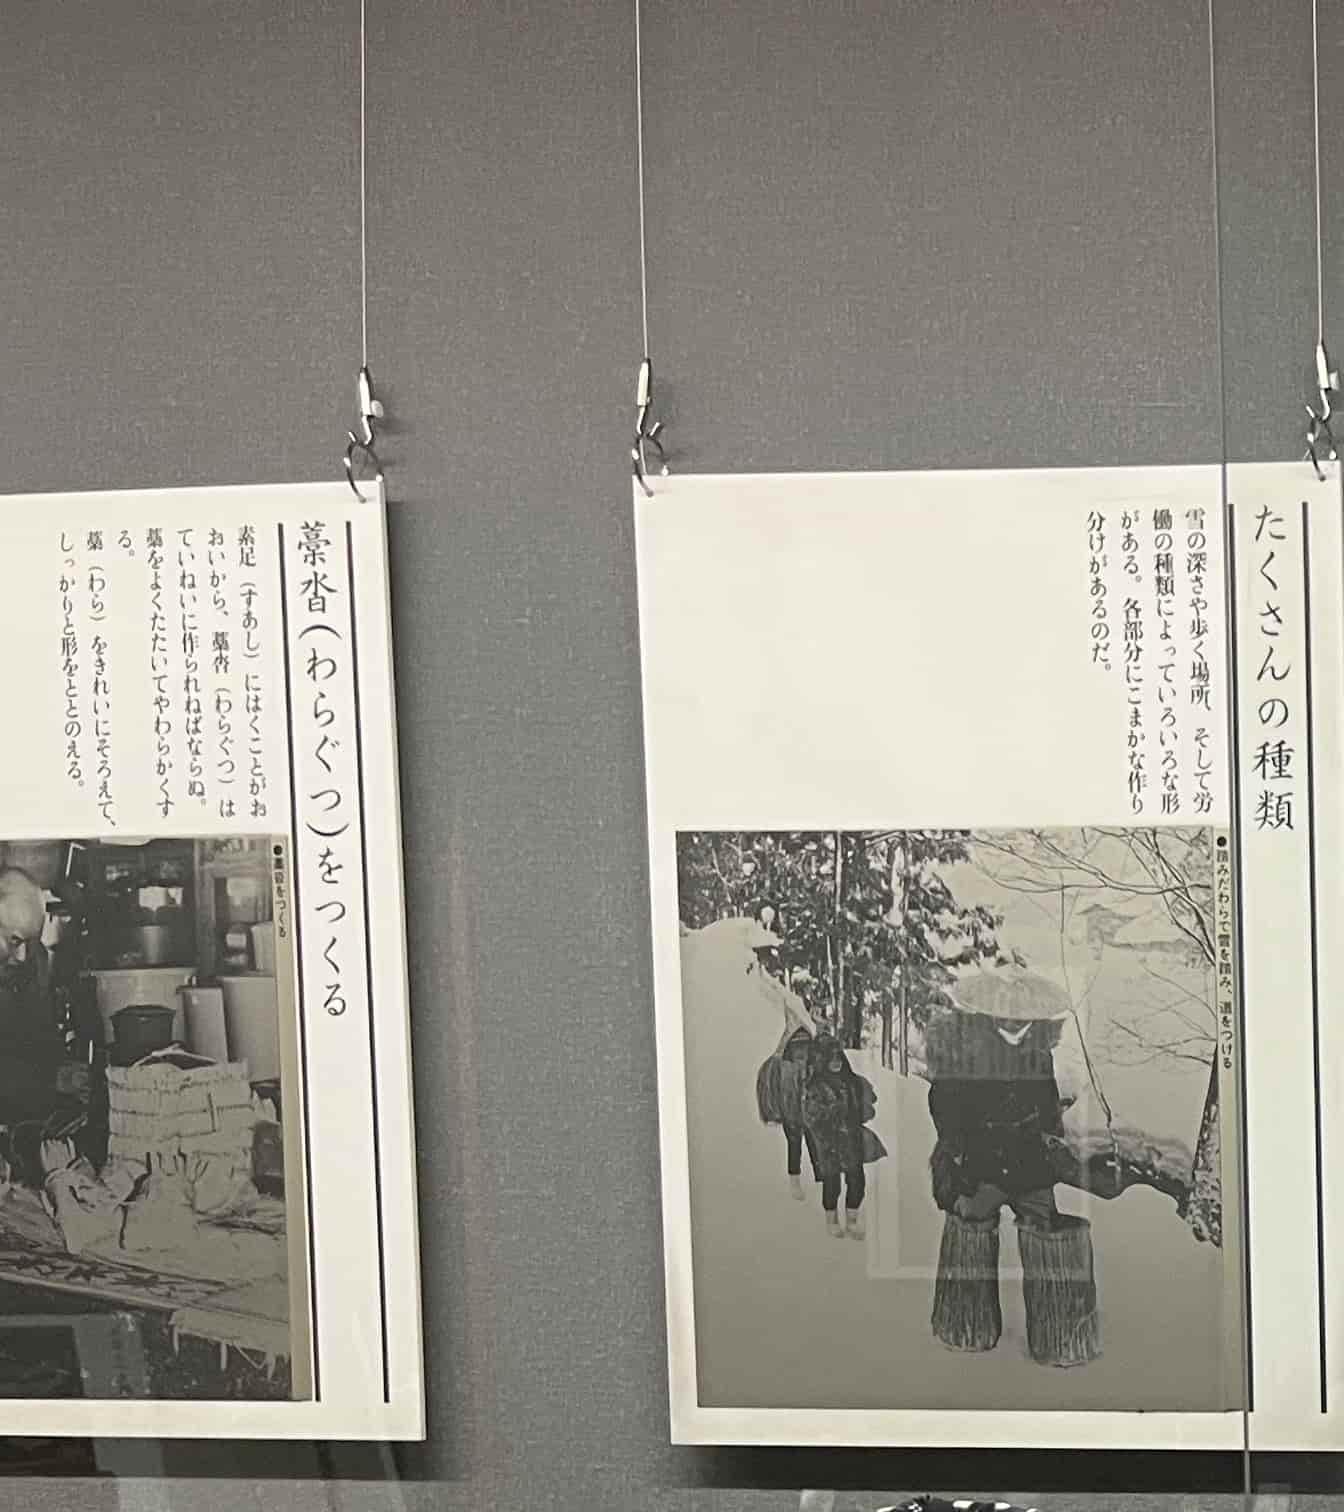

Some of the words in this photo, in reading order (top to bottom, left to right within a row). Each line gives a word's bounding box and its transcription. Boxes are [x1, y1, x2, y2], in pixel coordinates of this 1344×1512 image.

[1087, 510, 1112, 671] 分けがあるのだ。
[1120, 510, 1147, 815] がある。各部分にこまかな作り
[1152, 508, 1180, 815] 働の種類によっていろいろな形
[1184, 507, 1214, 815] 雪の深さや歩く場所、そして労
[1252, 504, 1296, 831] たくさんの種類
